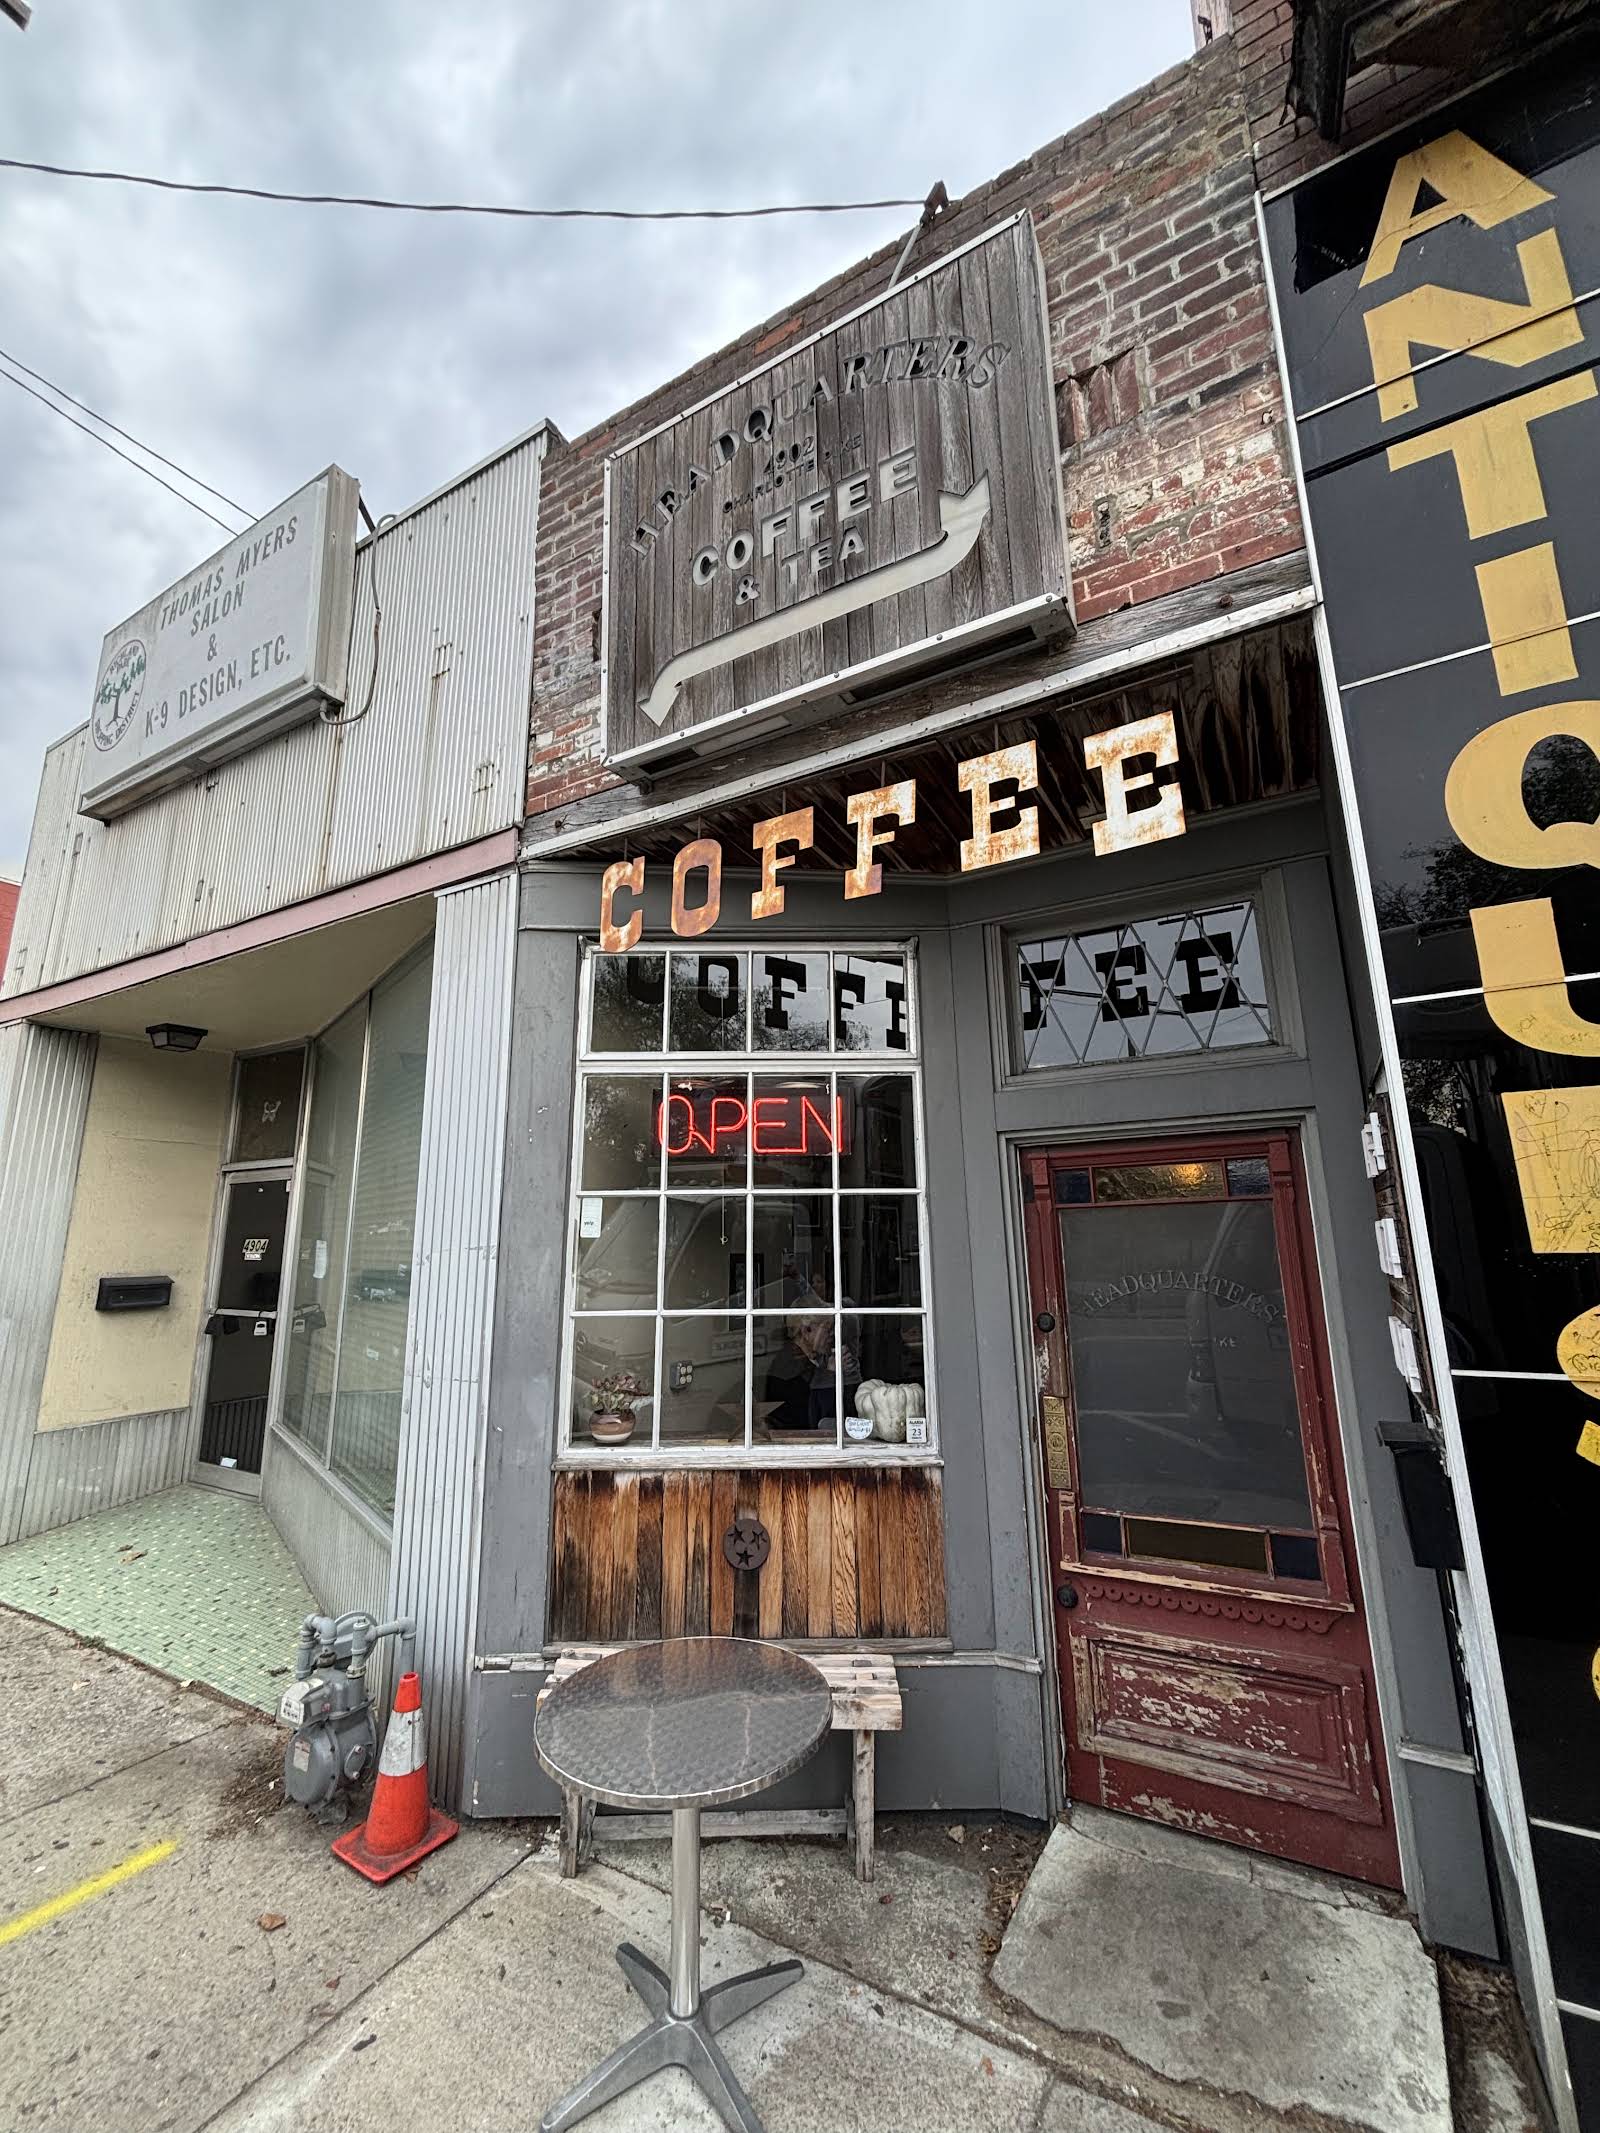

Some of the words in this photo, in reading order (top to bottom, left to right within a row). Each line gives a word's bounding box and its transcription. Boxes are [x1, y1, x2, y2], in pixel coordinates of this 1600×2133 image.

[629, 334, 1010, 560] HEADQUARTERS
[763, 435, 814, 475] 4902
[692, 446, 917, 586] COFFEE
[722, 458, 815, 514] CHARLOTTE
[161, 566, 224, 630] THOMAS
[235, 516, 298, 579] MYERS
[735, 574, 759, 605] &
[781, 526, 865, 584] TEA
[190, 580, 246, 637] SALON
[207, 633, 217, 662] &
[145, 701, 169, 738] K-9
[178, 660, 243, 719] DESIGN,
[250, 634, 291, 679] ETC.
[599, 710, 1187, 954] COFFEE
[657, 1094, 842, 1155] OPEN
[243, 1240, 267, 1252] 4904
[911, 1428, 922, 1436] 23
